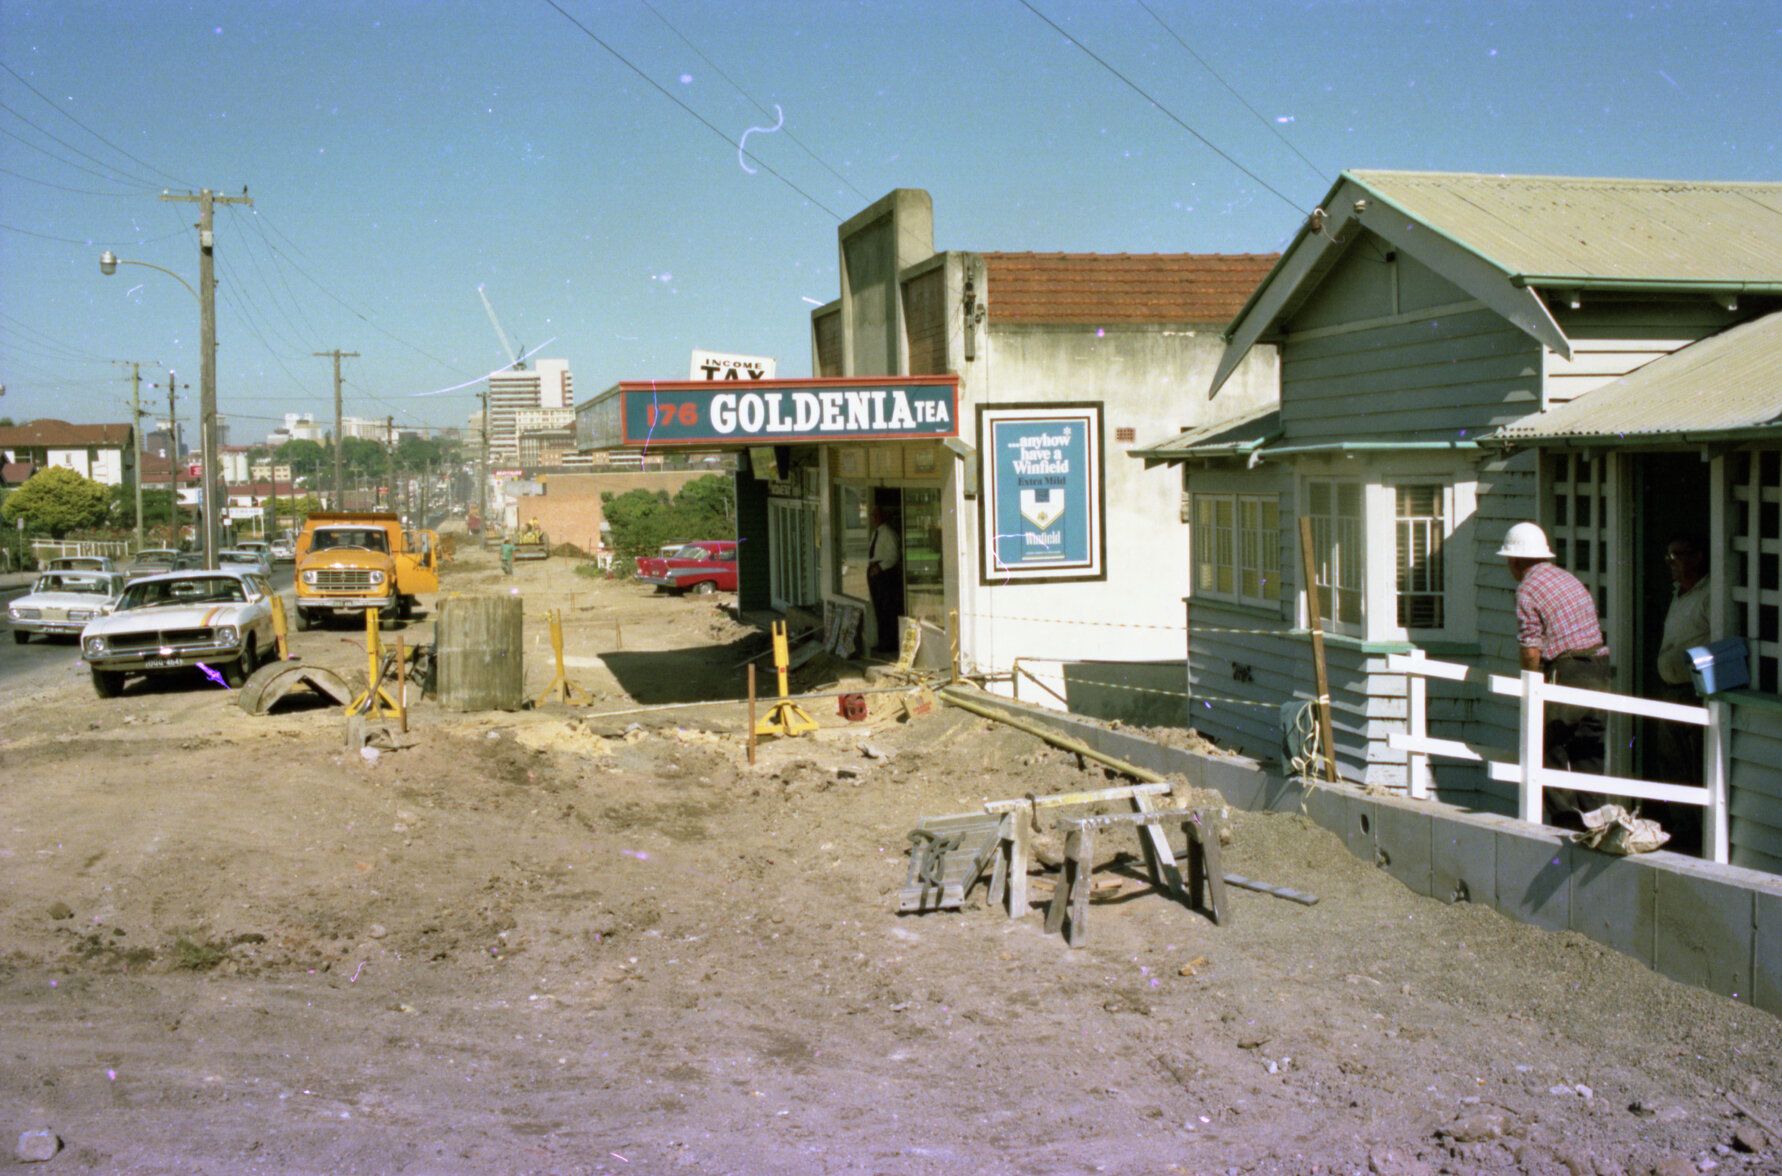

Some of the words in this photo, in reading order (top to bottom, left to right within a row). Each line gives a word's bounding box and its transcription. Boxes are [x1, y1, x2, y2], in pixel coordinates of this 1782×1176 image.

[705, 358, 762, 369] INCOME
[700, 365, 765, 381] TAX
[646, 402, 699, 427] 176
[709, 390, 916, 434] GOLDENIA
[915, 400, 949, 423] TEA
[1020, 448, 1052, 461] have
[1053, 450, 1062, 460] a
[1012, 460, 1070, 475] Winfield
[1018, 477, 1043, 487] Extra
[1044, 476, 1067, 486] Mild
[1025, 530, 1061, 546] Winfield
